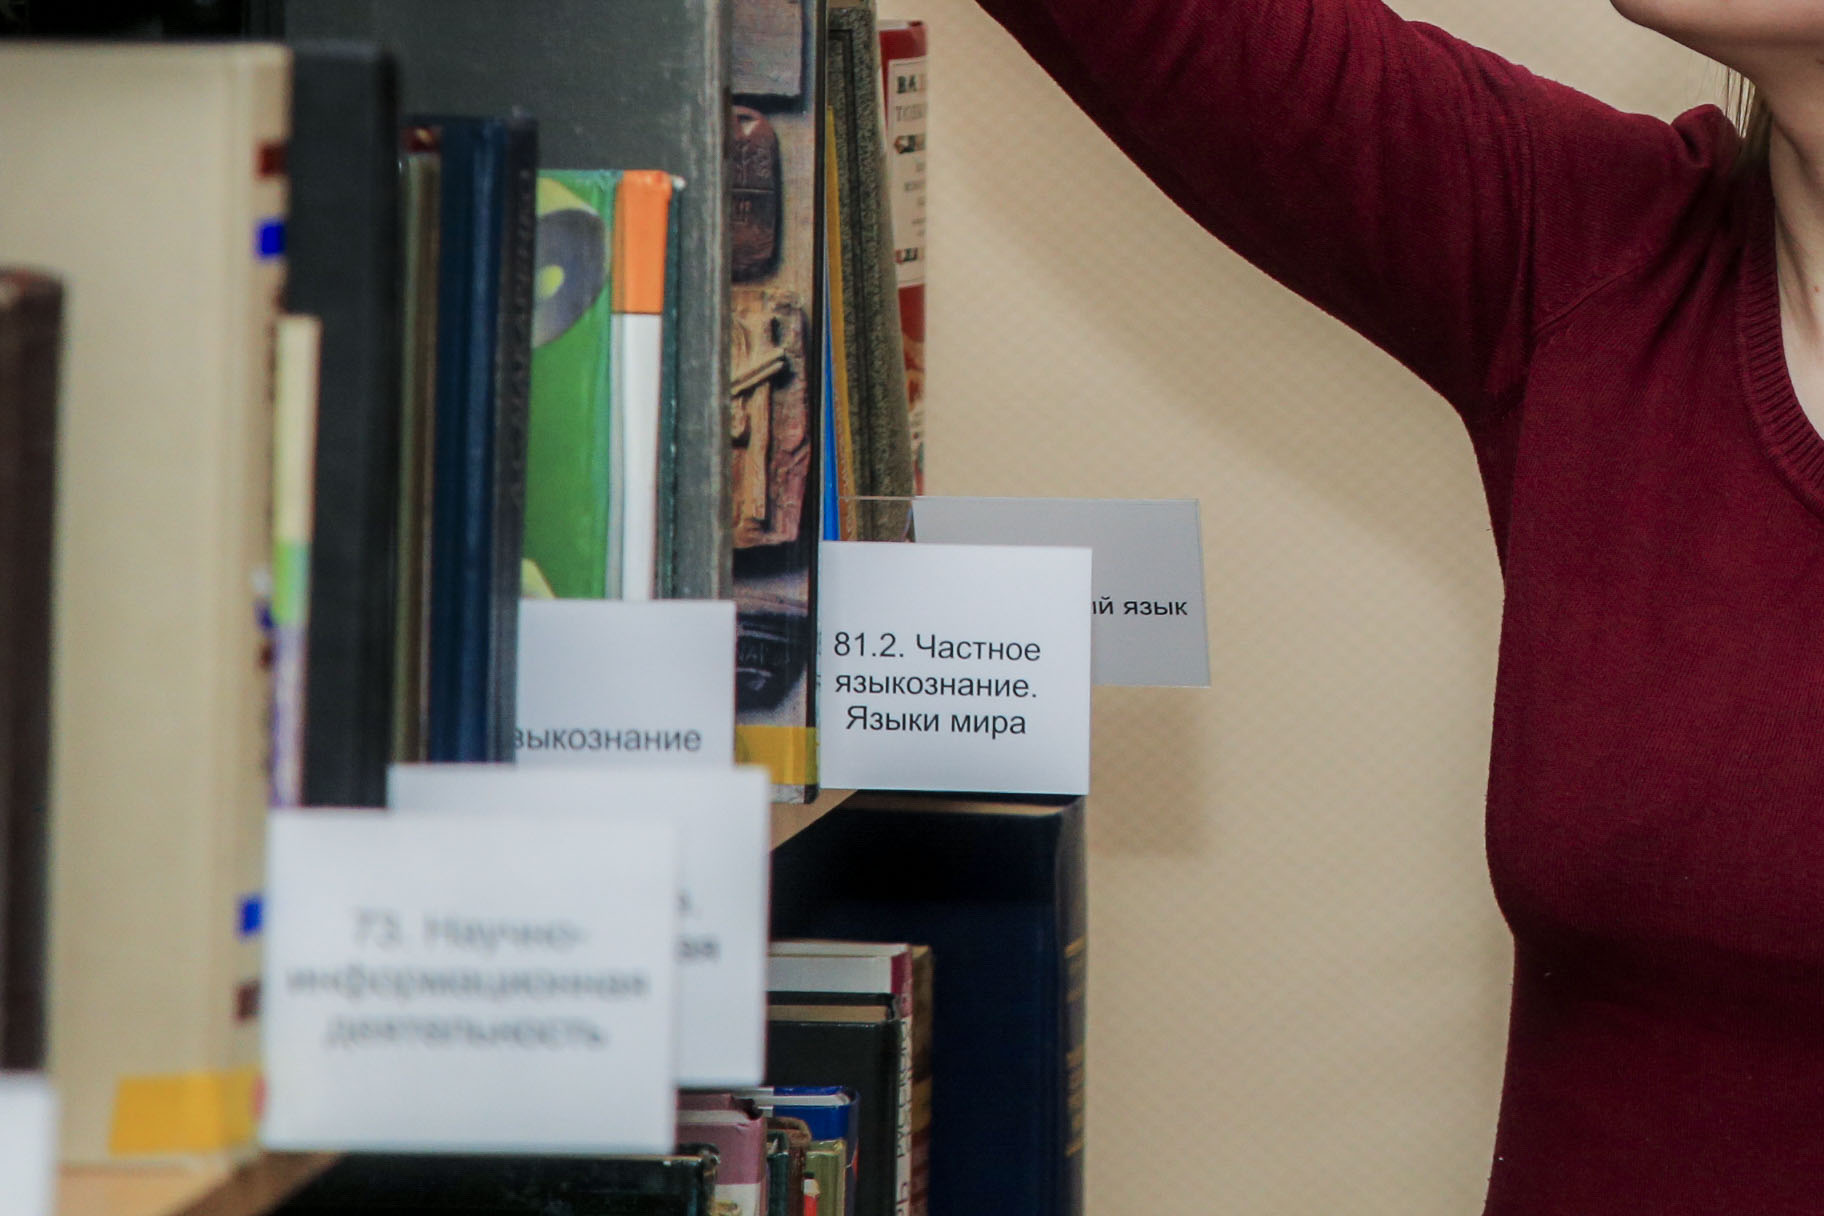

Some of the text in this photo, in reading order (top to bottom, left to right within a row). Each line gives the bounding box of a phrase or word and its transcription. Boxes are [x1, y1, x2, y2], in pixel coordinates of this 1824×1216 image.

[1123, 600, 1188, 616] язык
[833, 631, 1041, 661] 81.2. Частное
[835, 674, 1037, 698] языкознание.
[846, 705, 1026, 740] Языки мира
[285, 964, 650, 1006] информационная
[325, 1014, 610, 1051] деятельность
